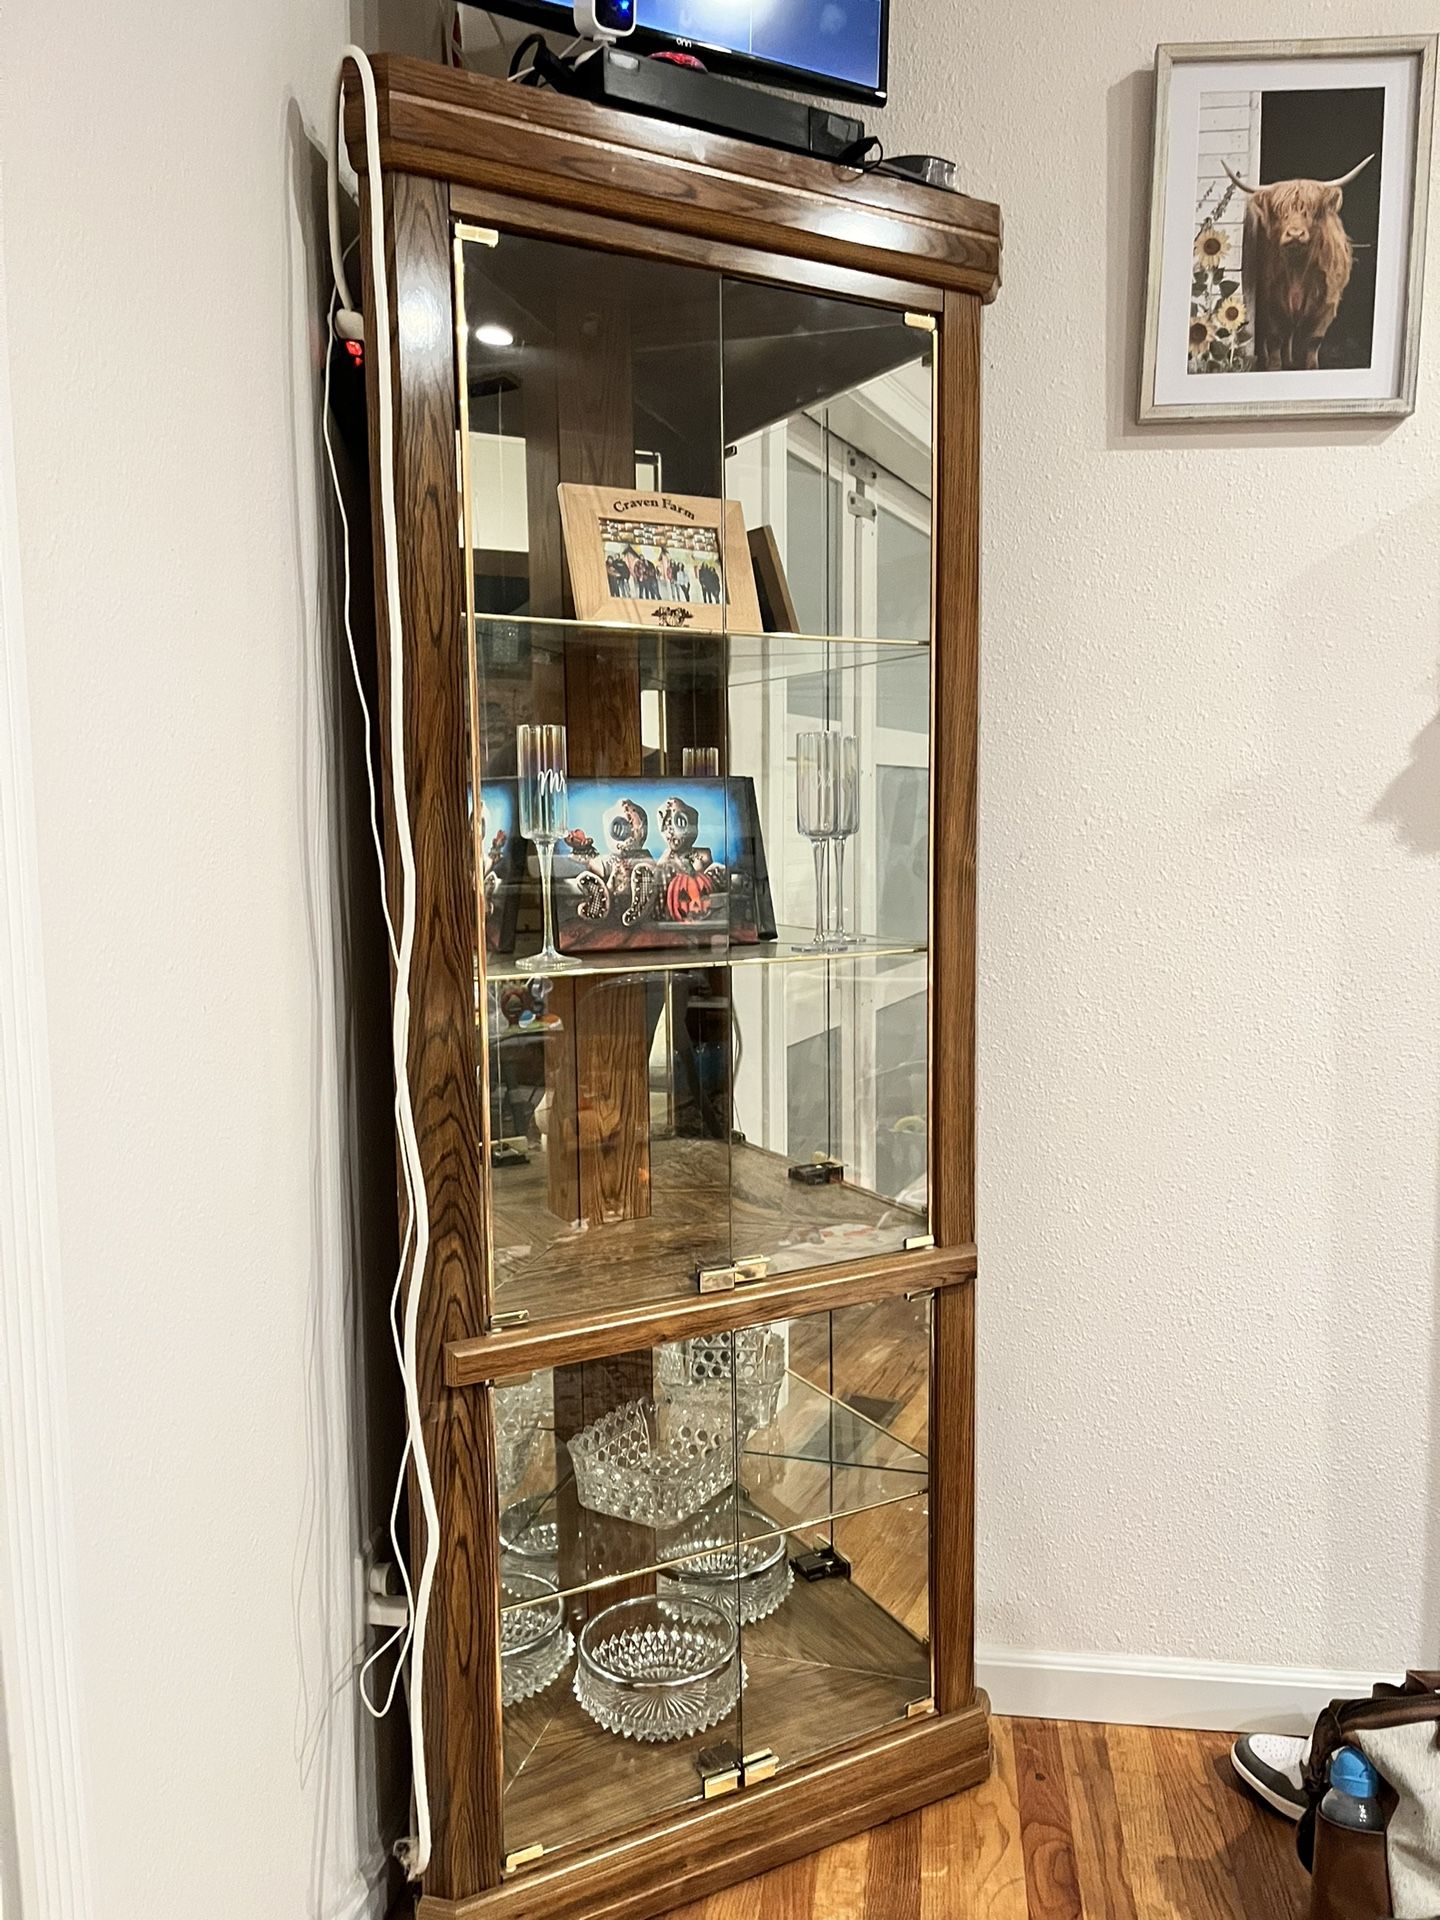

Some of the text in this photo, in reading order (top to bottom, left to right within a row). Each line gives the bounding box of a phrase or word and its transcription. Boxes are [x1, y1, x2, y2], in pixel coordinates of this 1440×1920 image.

[676, 37, 692, 48] onn
[613, 498, 695, 520] Craven Farm
